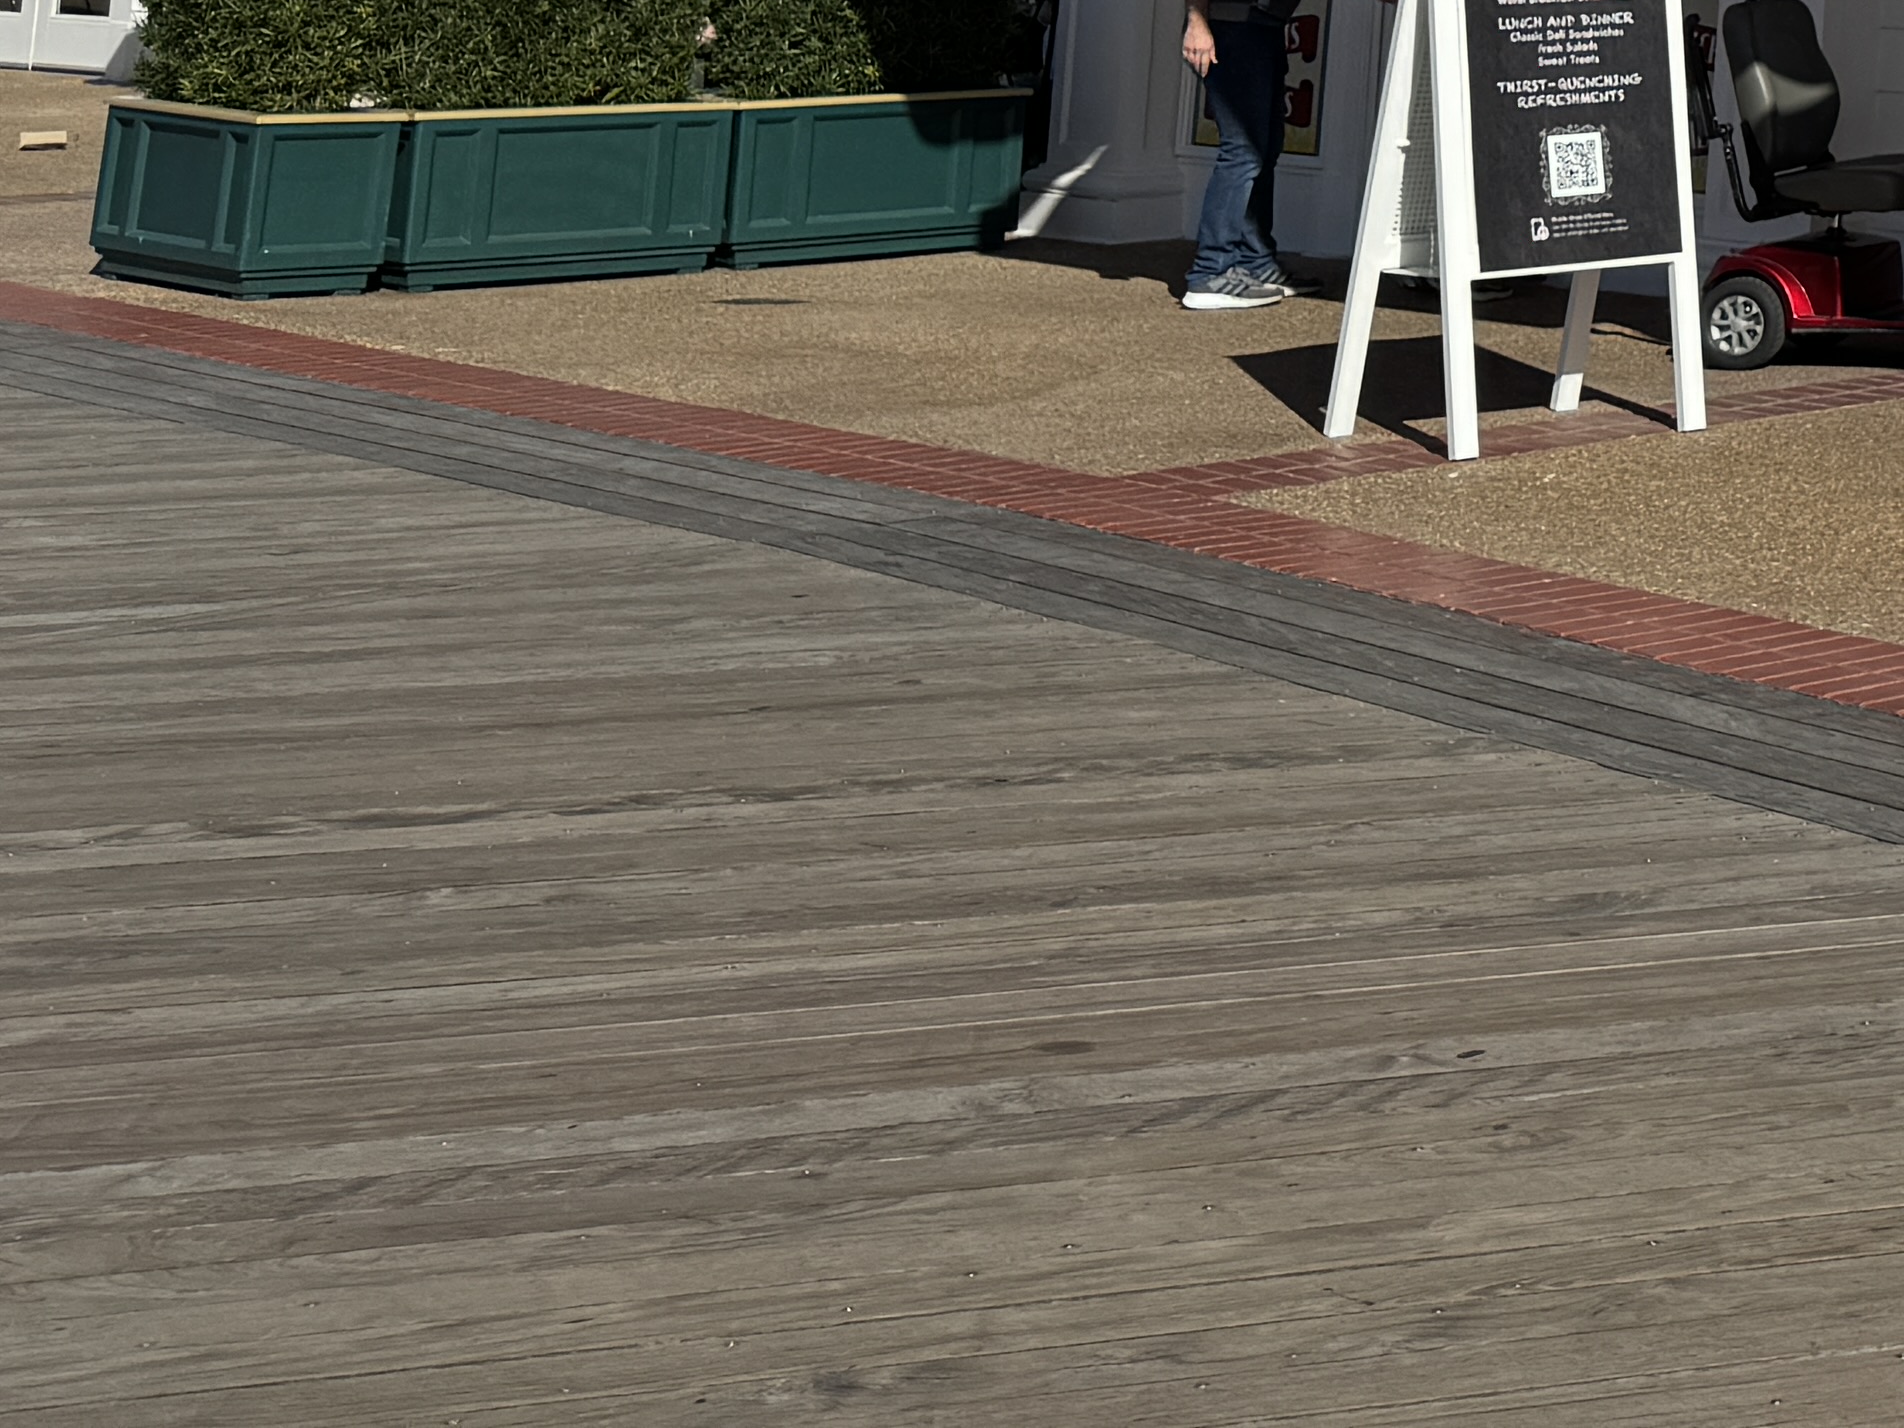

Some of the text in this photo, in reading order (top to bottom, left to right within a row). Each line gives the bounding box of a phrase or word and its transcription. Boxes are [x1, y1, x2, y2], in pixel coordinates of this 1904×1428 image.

[1498, 11, 1634, 30] LUNCH AND DINNER
[1546, 29, 1565, 41] Deli
[1568, 26, 1624, 40] Sandwiches
[1496, 73, 1643, 94] THIRST-QUENCHING
[1517, 89, 1625, 109] REFRESHMENTS
